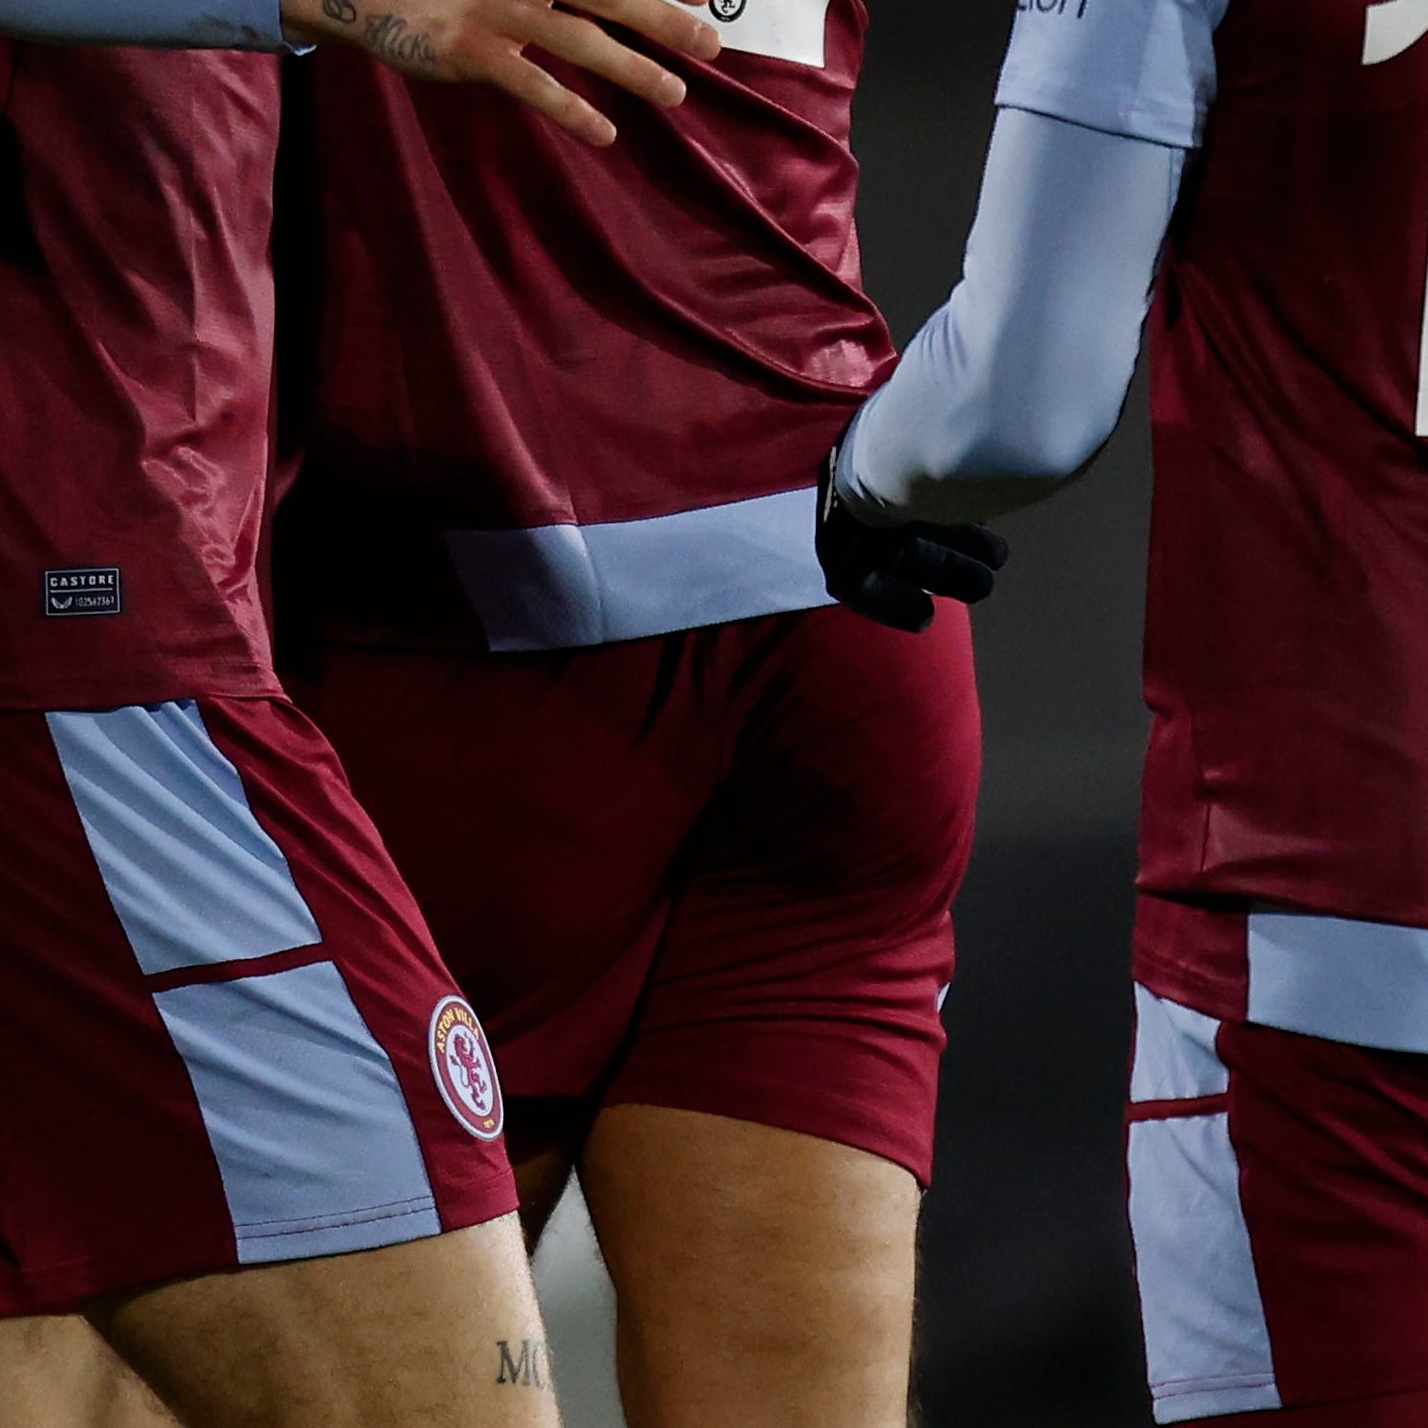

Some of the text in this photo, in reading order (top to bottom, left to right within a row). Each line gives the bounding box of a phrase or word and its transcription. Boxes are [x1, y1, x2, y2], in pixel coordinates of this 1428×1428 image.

[50, 575, 114, 587] CASTORE
[436, 1007, 479, 1054] ASTON VILLA
